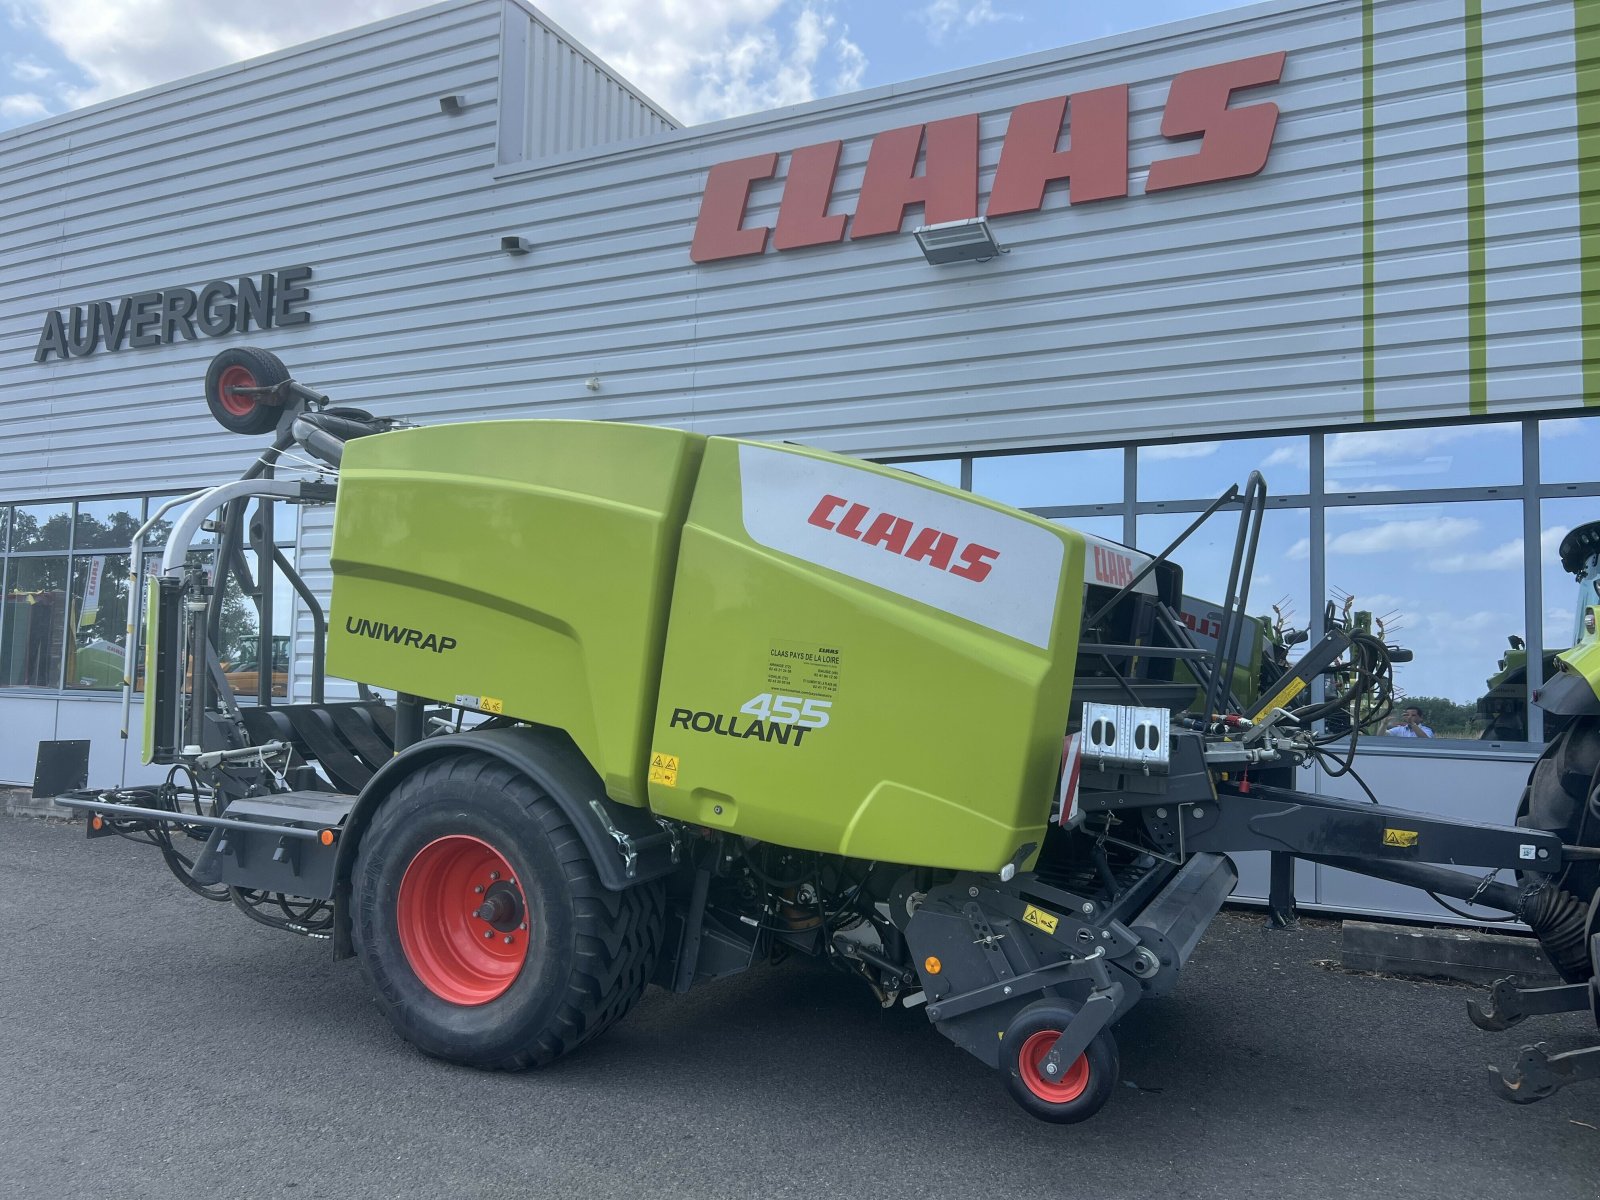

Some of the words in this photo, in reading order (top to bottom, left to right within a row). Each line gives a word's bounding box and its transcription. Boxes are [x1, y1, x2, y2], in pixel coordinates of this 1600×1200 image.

[690, 51, 1286, 263] CLAAS
[34, 266, 312, 362] AUVERGNE
[807, 494, 1000, 583] CLAAS
[1094, 544, 1134, 587] CLAAS
[345, 616, 457, 653] UNIWRAP
[771, 649, 789, 657] CLAAS
[789, 651, 804, 660] PAYS
[805, 653, 813, 661] DE
[822, 656, 840, 665] LOIRE
[669, 707, 812, 747] ROLLANT
[740, 693, 832, 729] 455
